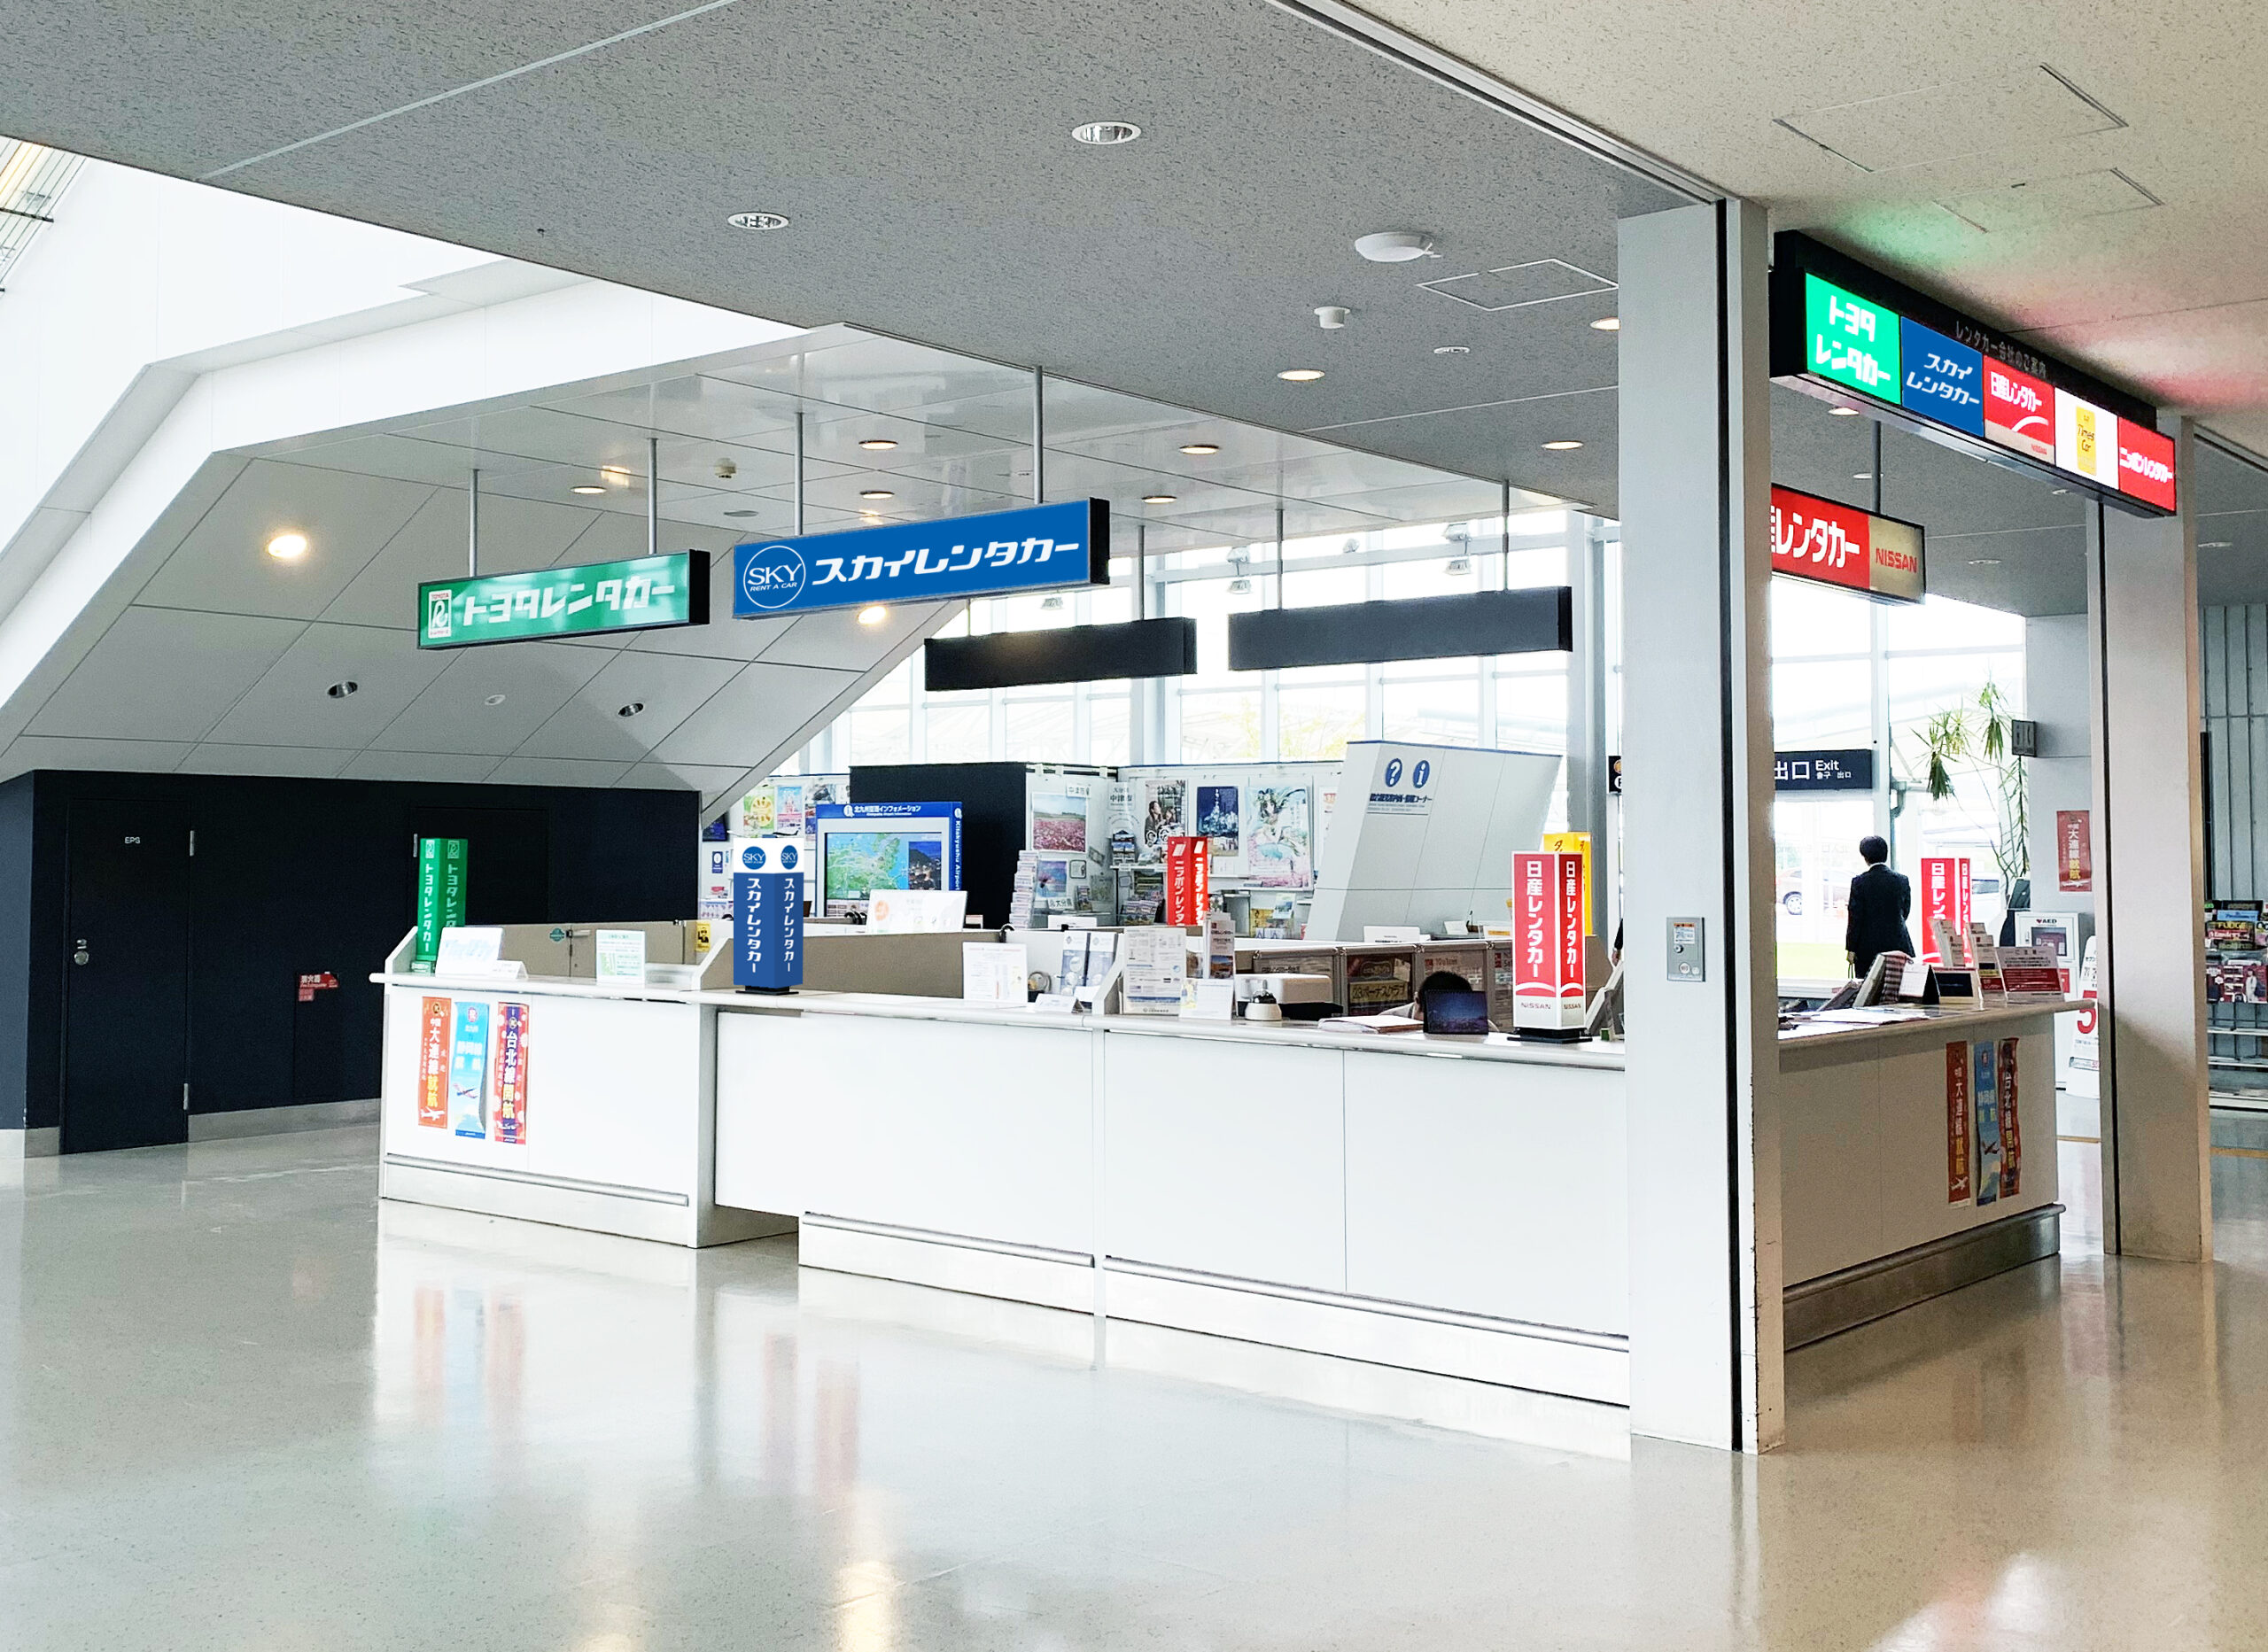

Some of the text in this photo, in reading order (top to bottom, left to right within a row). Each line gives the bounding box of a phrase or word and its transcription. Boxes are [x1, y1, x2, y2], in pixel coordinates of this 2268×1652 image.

[1829, 295, 1876, 342] トヨタ
[1816, 334, 1891, 386] レンタカー
[1923, 353, 1973, 380] スカイ
[1907, 371, 1980, 405] レンタカー
[1990, 370, 2042, 412] 日産レンタカー
[812, 537, 1079, 586] スカイレンタカー
[1771, 506, 1860, 568] レンタカー
[1876, 547, 1918, 573] NISSAN
[747, 562, 802, 586] SKY
[462, 576, 675, 625] トヨタレンタカー
[1774, 761, 1810, 780] 出口
[1815, 760, 1840, 771] Exit
[781, 852, 798, 861] SKY
[423, 863, 434, 952] トヨタレンタカー
[446, 864, 459, 927] トヨタレンタ
[1174, 860, 1184, 926] ニッポンレンタ
[1194, 857, 1204, 926] ニッポンレンタ
[1930, 862, 1946, 919] 日産レン
[747, 878, 762, 973] スカイレンタカー
[784, 878, 795, 973] スカイレンタカー
[1526, 860, 1543, 978] 日産レンタカー
[1565, 860, 1577, 978] 日産レンタカー
